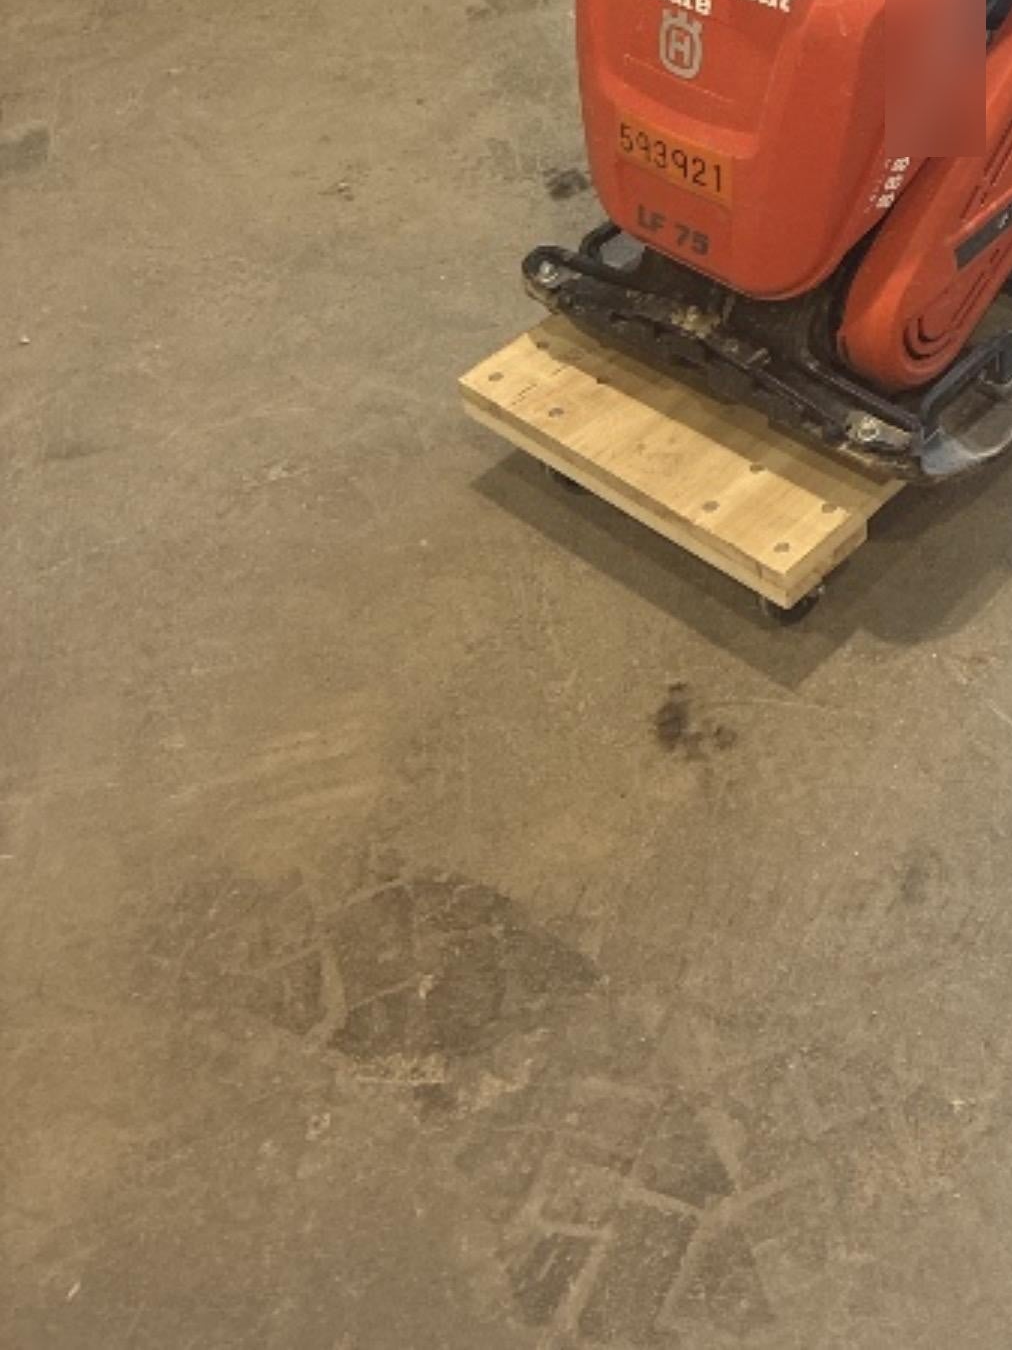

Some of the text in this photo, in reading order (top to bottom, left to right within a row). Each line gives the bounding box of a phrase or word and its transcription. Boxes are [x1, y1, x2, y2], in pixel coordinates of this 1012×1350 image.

[619, 121, 722, 193] 593921
[637, 203, 710, 257] LF 75
